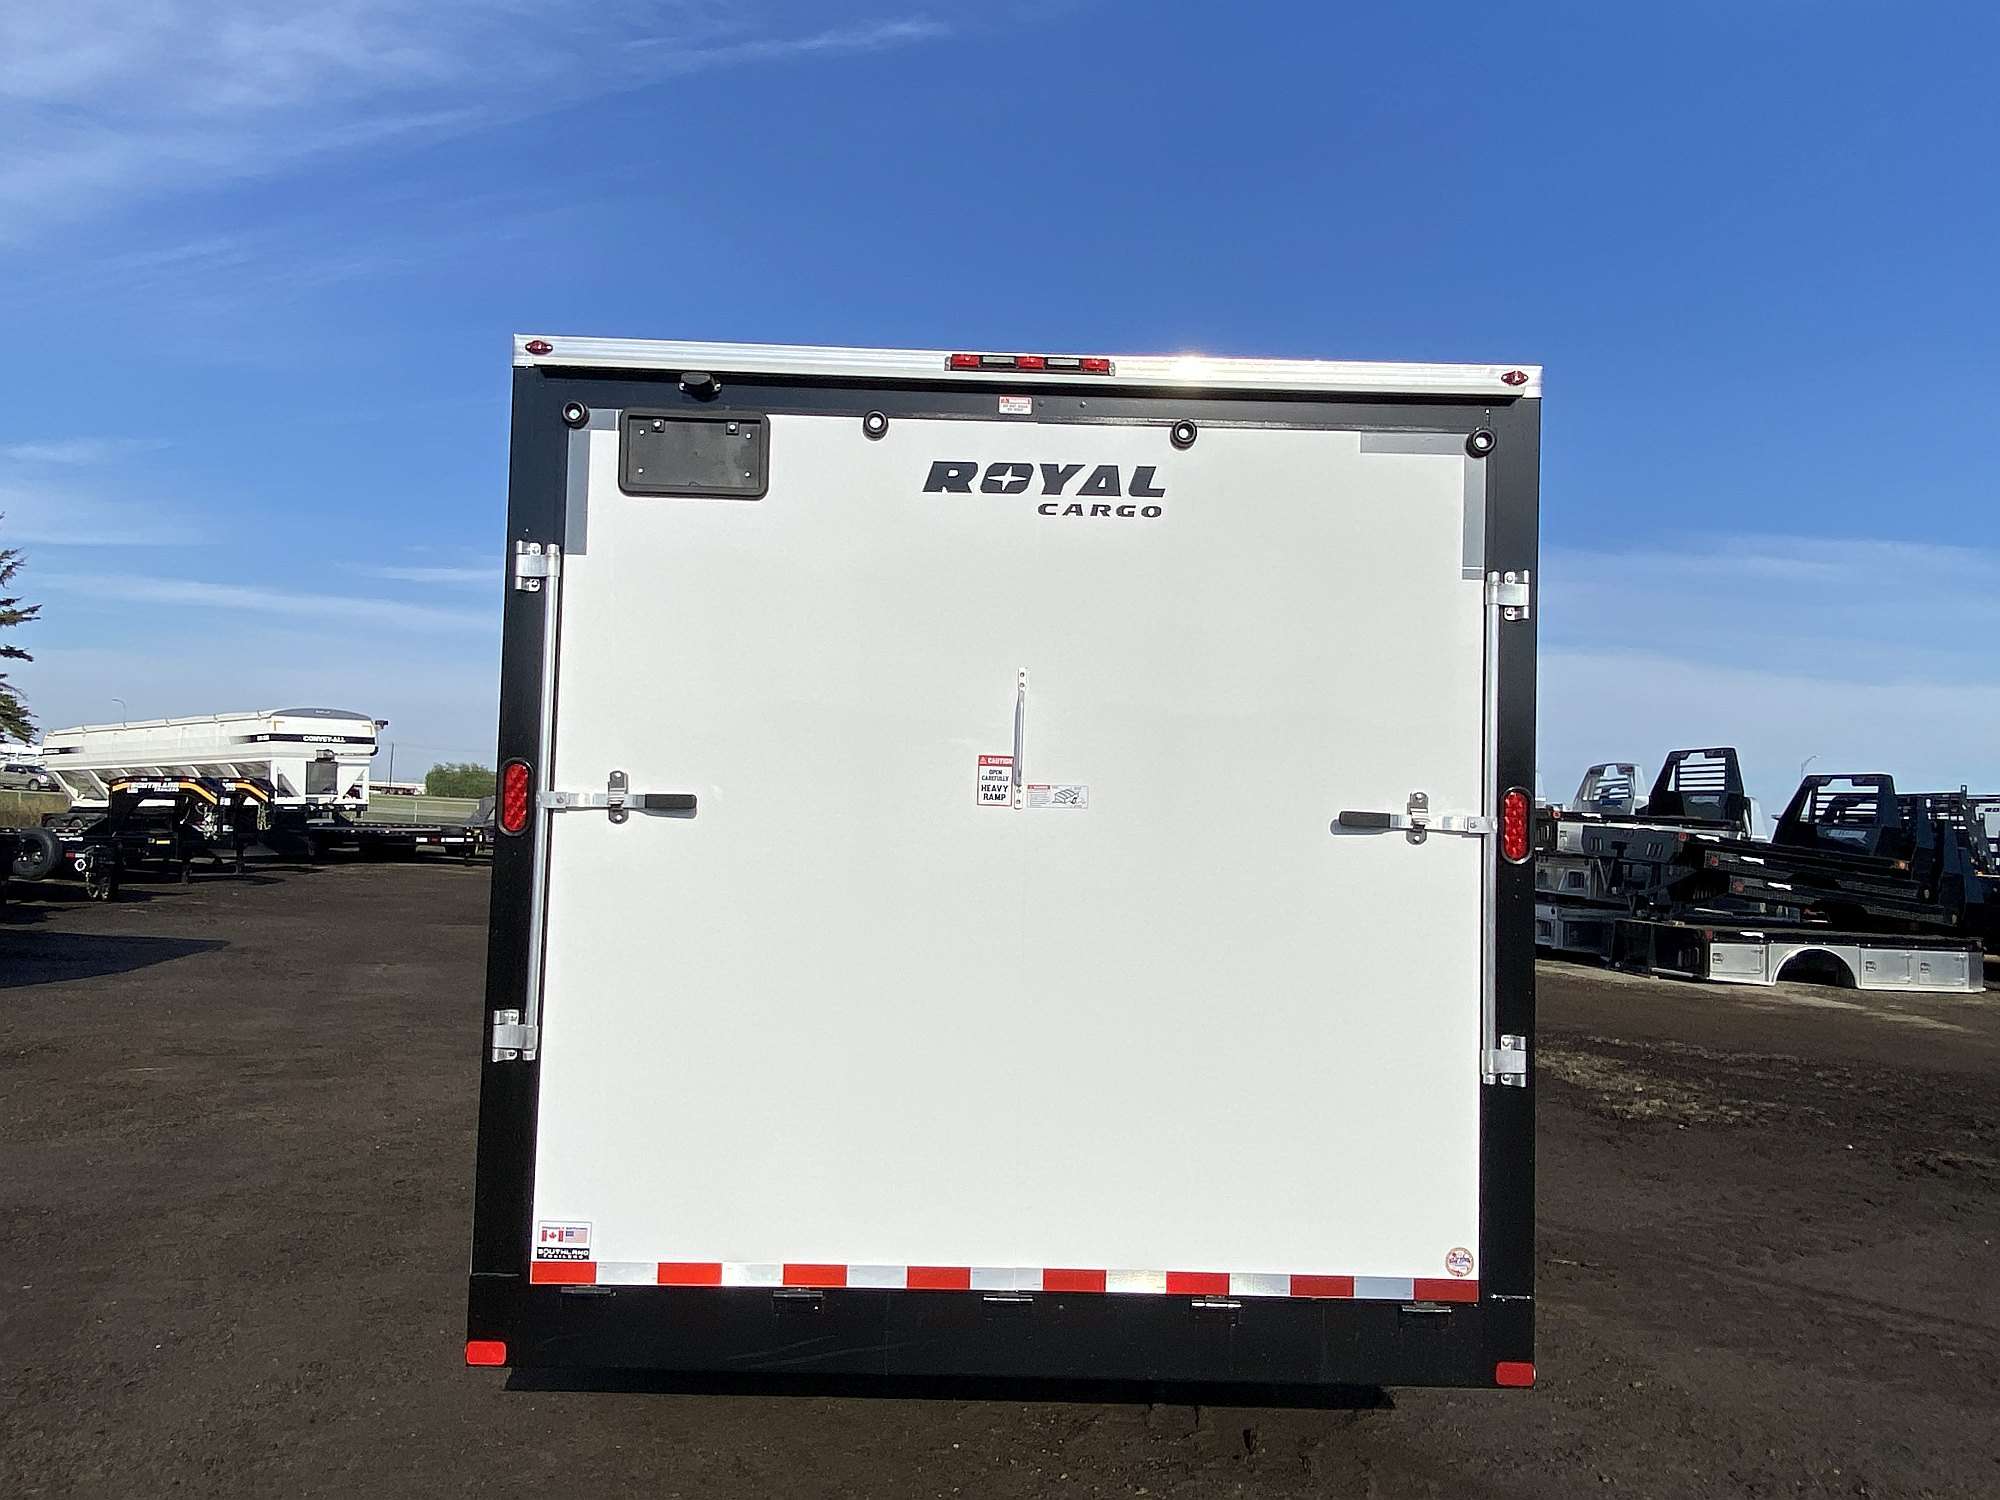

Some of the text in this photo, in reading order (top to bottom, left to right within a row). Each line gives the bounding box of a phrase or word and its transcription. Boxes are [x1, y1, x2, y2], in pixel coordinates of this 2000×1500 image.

[922, 461, 1166, 497] ROYAL
[1037, 503, 1162, 518] CARGO
[981, 784, 1008, 792] HEAVY
[983, 793, 1007, 801] RAMP
[537, 1248, 590, 1256] SOUTHLAND
